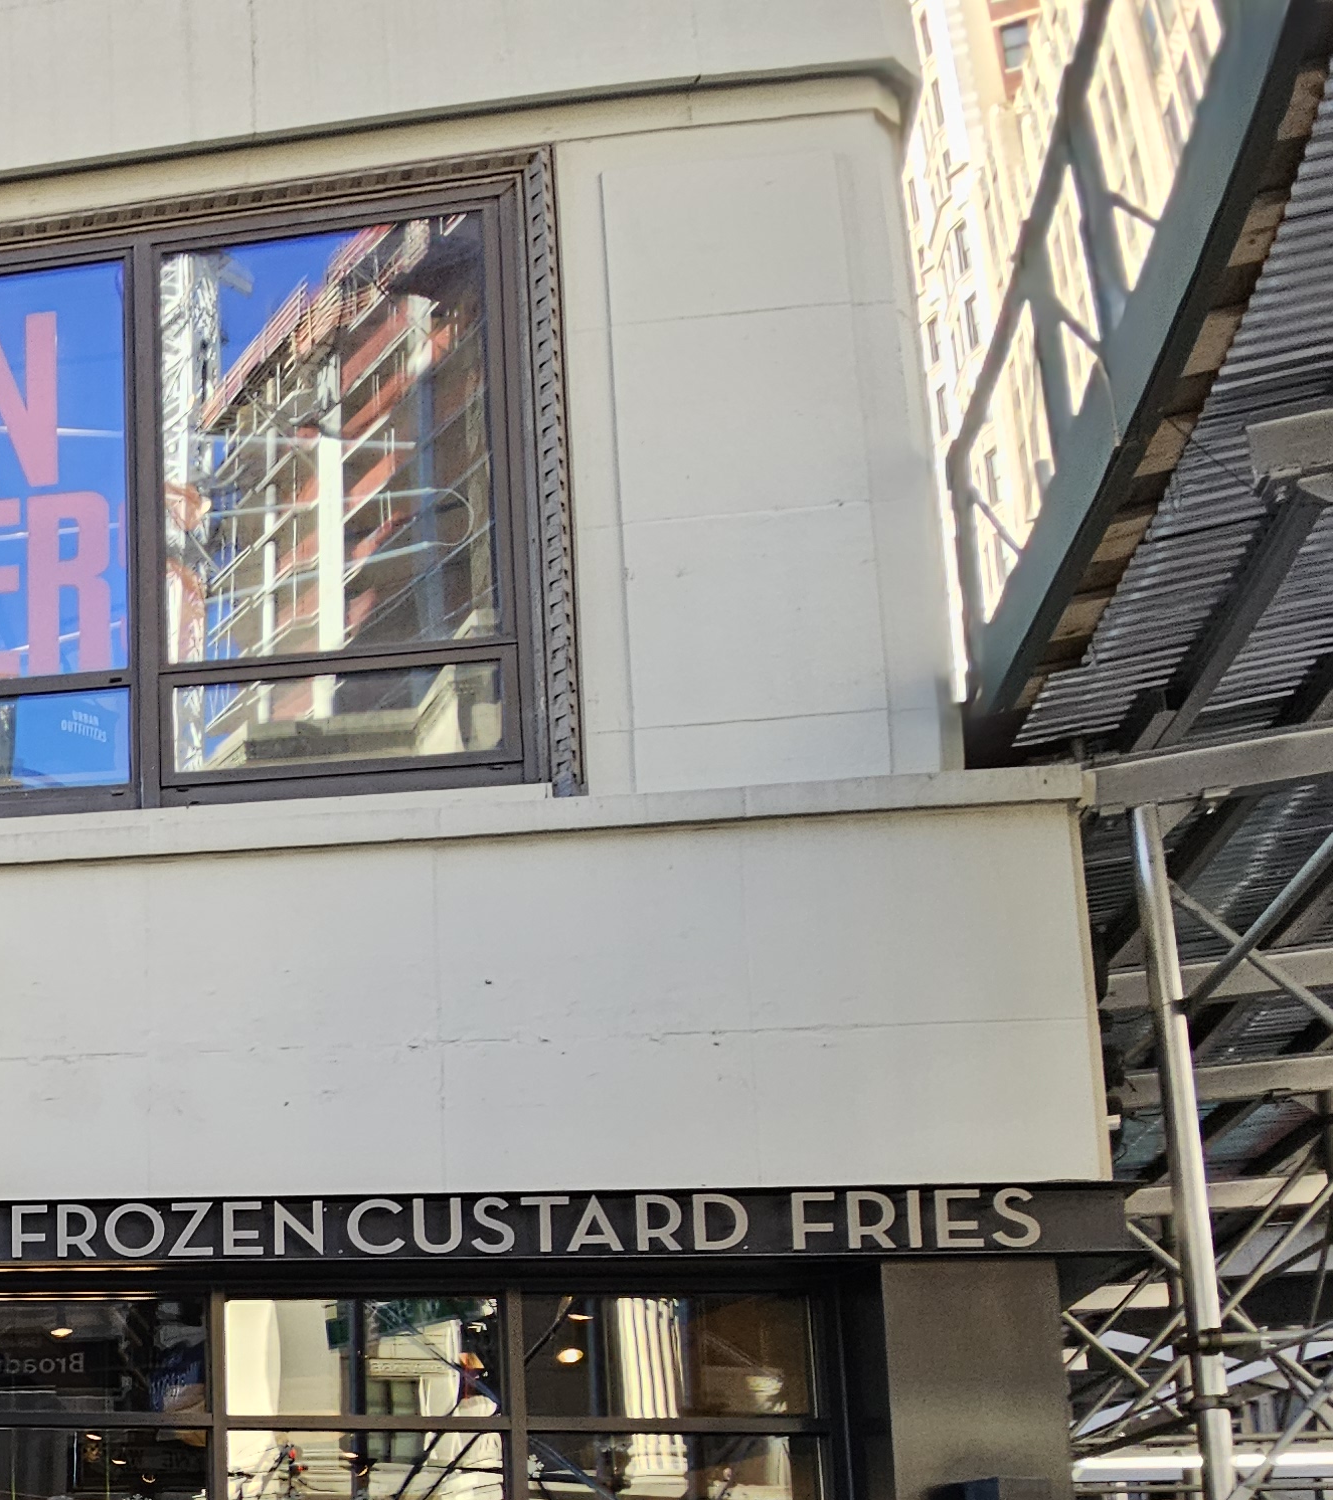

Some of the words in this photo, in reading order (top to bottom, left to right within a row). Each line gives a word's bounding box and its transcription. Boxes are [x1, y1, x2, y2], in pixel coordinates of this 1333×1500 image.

[71, 709, 100, 726] URBAN
[60, 719, 107, 743] OUTFITTERS
[11, 1199, 326, 1260] FROZEN
[346, 1190, 749, 1257] CUSTARD
[791, 1187, 1043, 1253] FRIES
